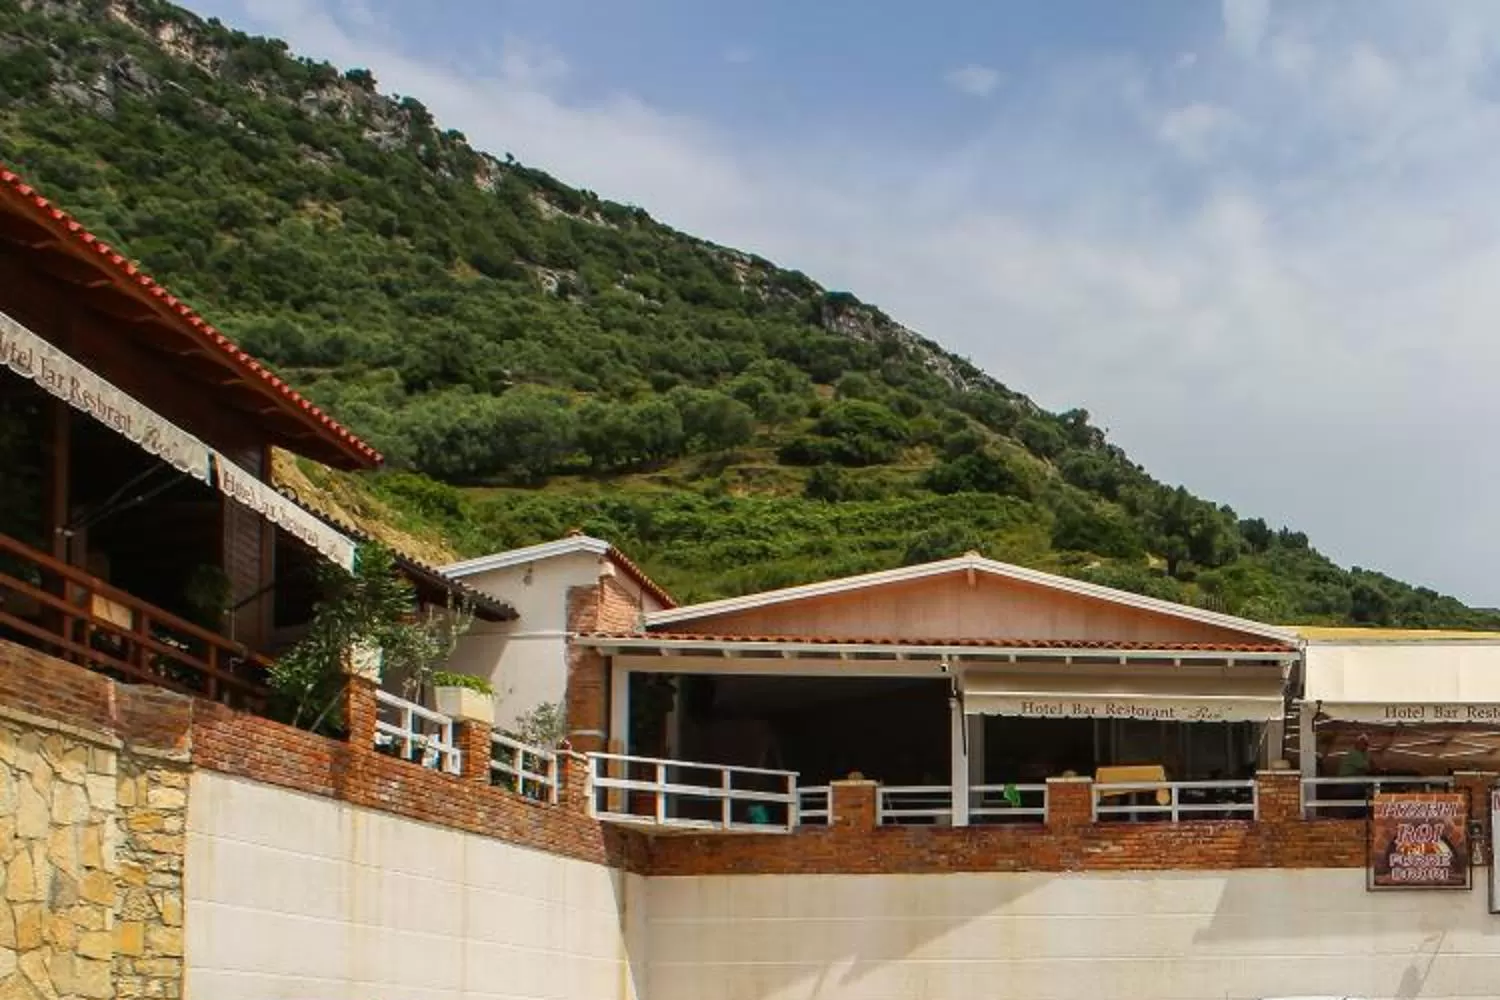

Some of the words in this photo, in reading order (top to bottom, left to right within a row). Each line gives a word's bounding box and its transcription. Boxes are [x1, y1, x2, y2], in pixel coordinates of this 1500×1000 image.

[1022, 701, 1063, 715] Hotel
[1073, 703, 1096, 715] Bar
[1105, 703, 1176, 718] Restorant
[1384, 705, 1425, 719] Hotel
[1434, 706, 1459, 719] Bar
